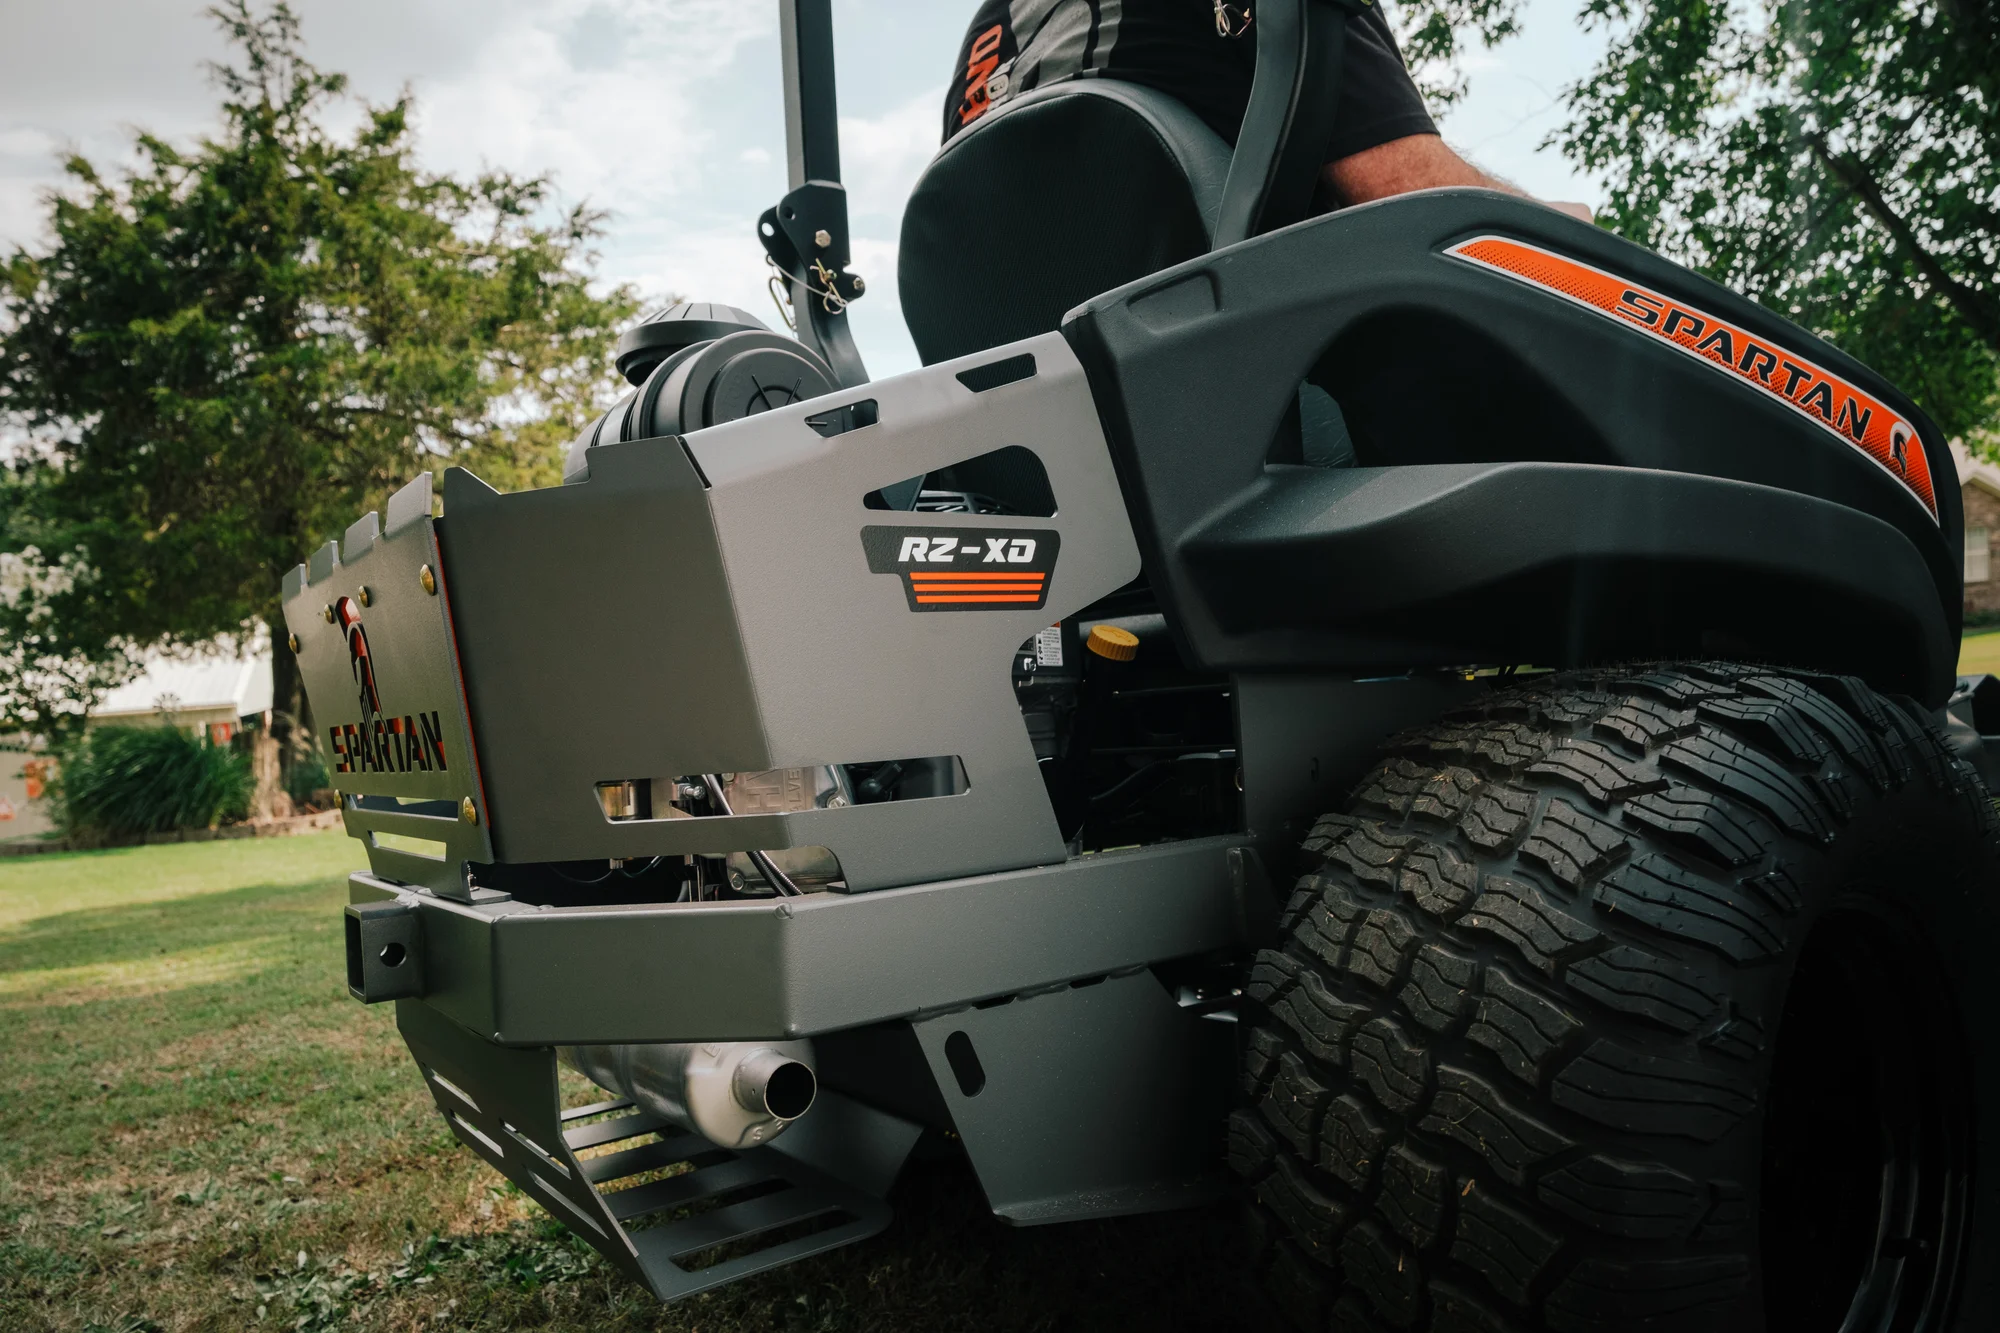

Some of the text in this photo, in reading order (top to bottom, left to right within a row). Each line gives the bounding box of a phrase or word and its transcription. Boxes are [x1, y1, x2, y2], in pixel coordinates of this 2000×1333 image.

[1615, 289, 1873, 443] SPARTAN
[898, 536, 1037, 563] RZ-XD
[329, 710, 448, 773] SPARTAN
